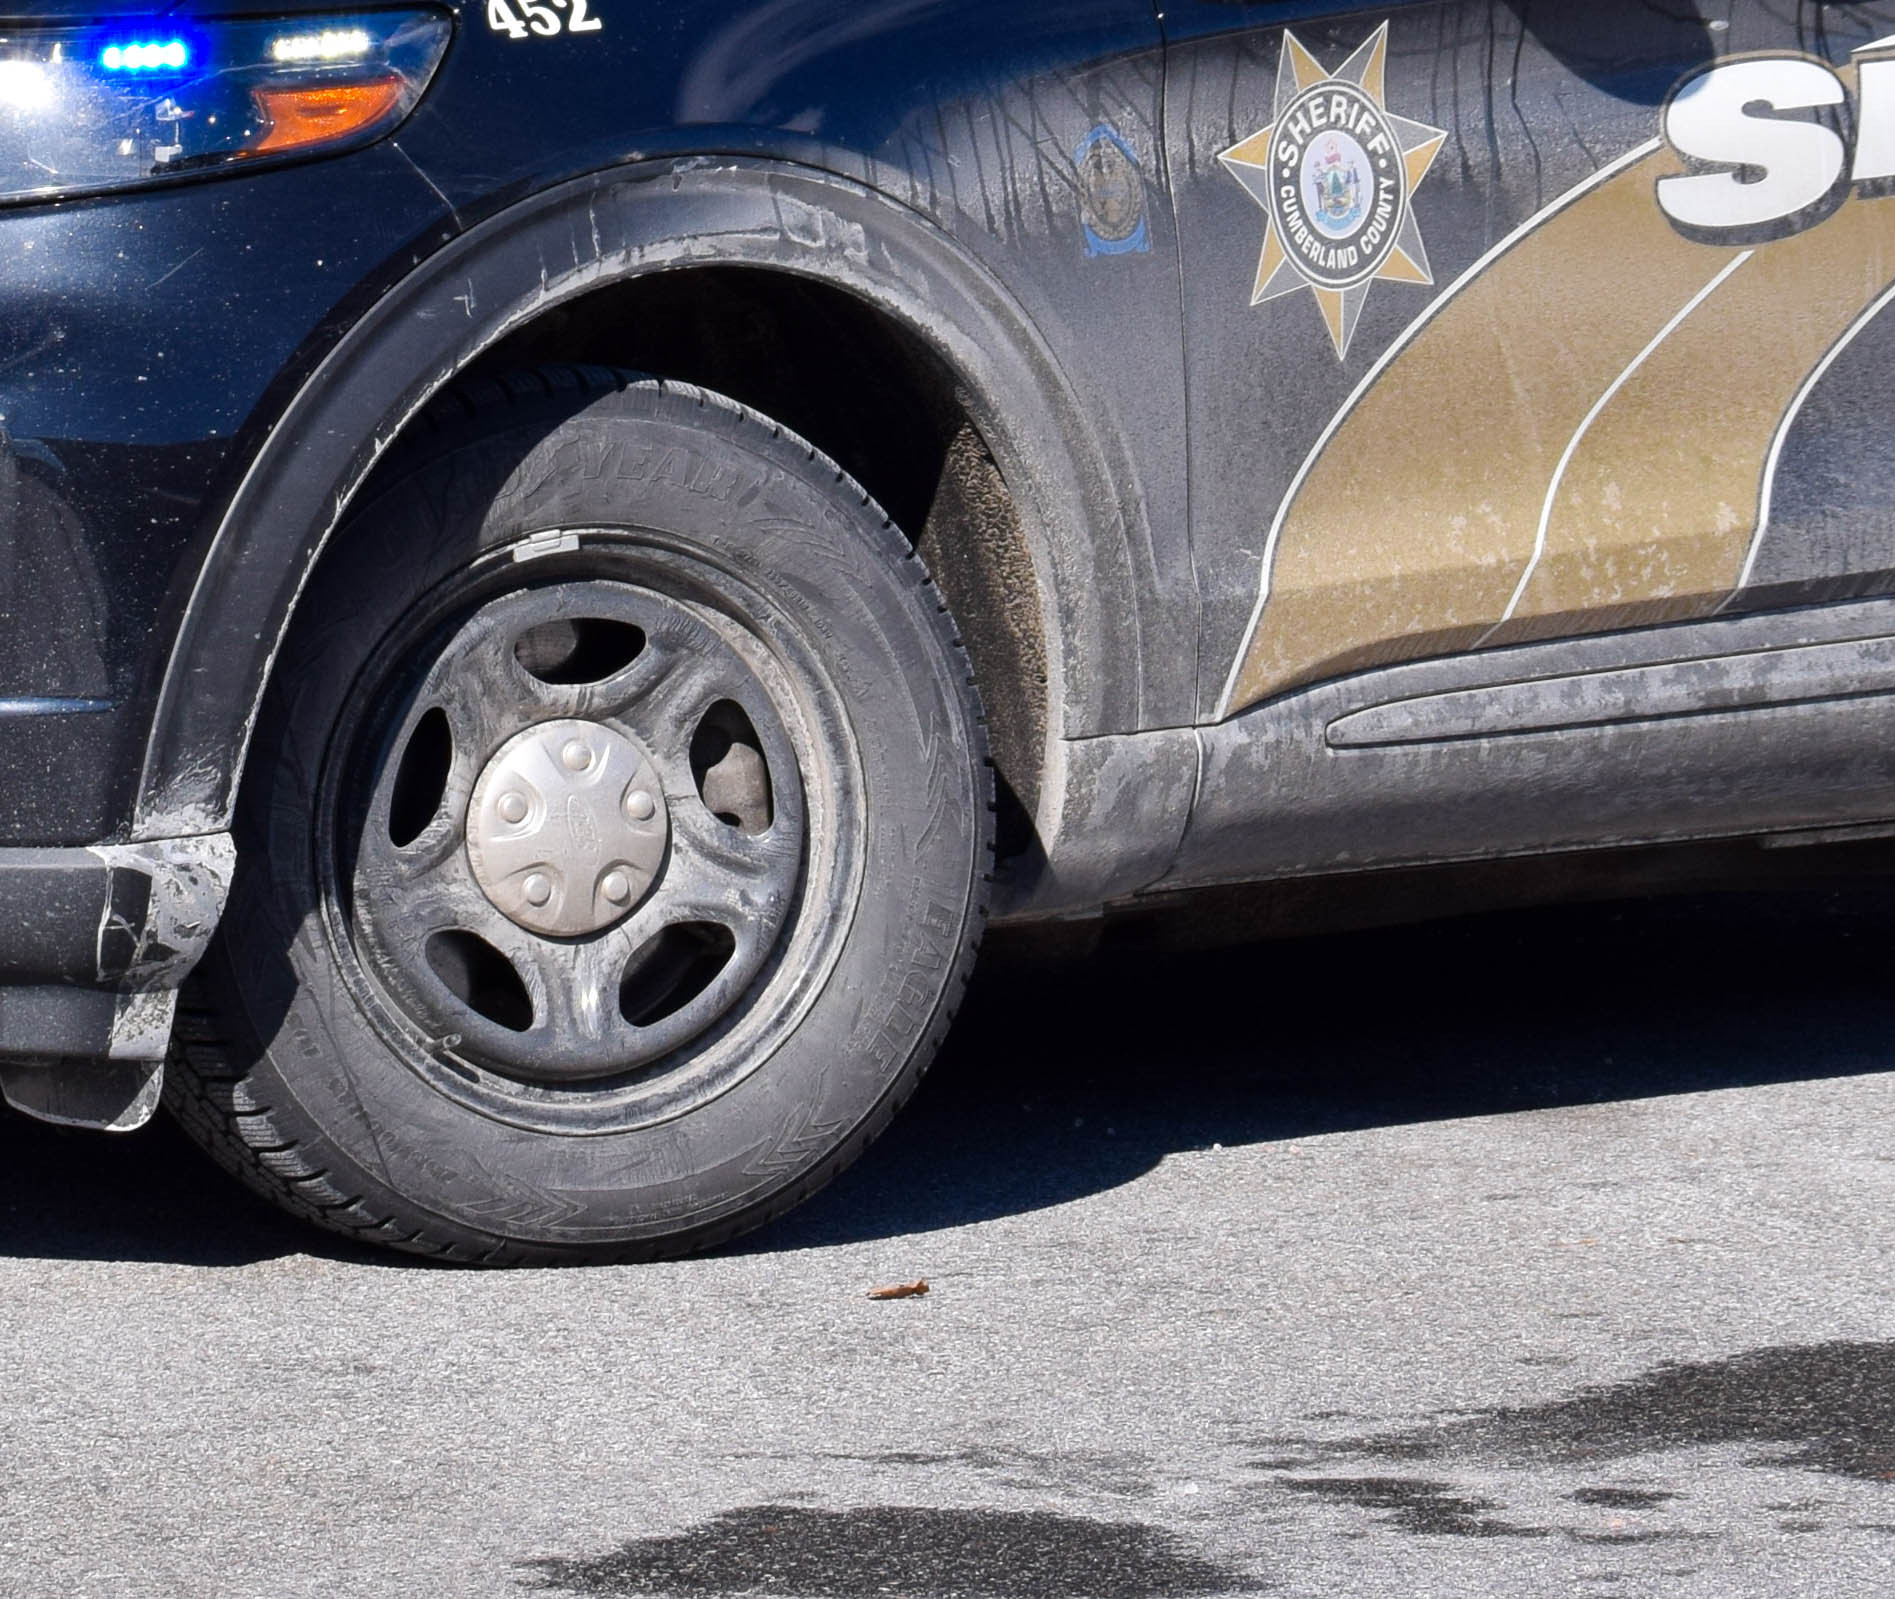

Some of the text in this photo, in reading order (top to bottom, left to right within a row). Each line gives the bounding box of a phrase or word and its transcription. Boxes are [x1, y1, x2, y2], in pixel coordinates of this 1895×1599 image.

[1277, 94, 1391, 168] SHERIFF
[1280, 175, 1396, 270] CUMBERLAND COUNTY
